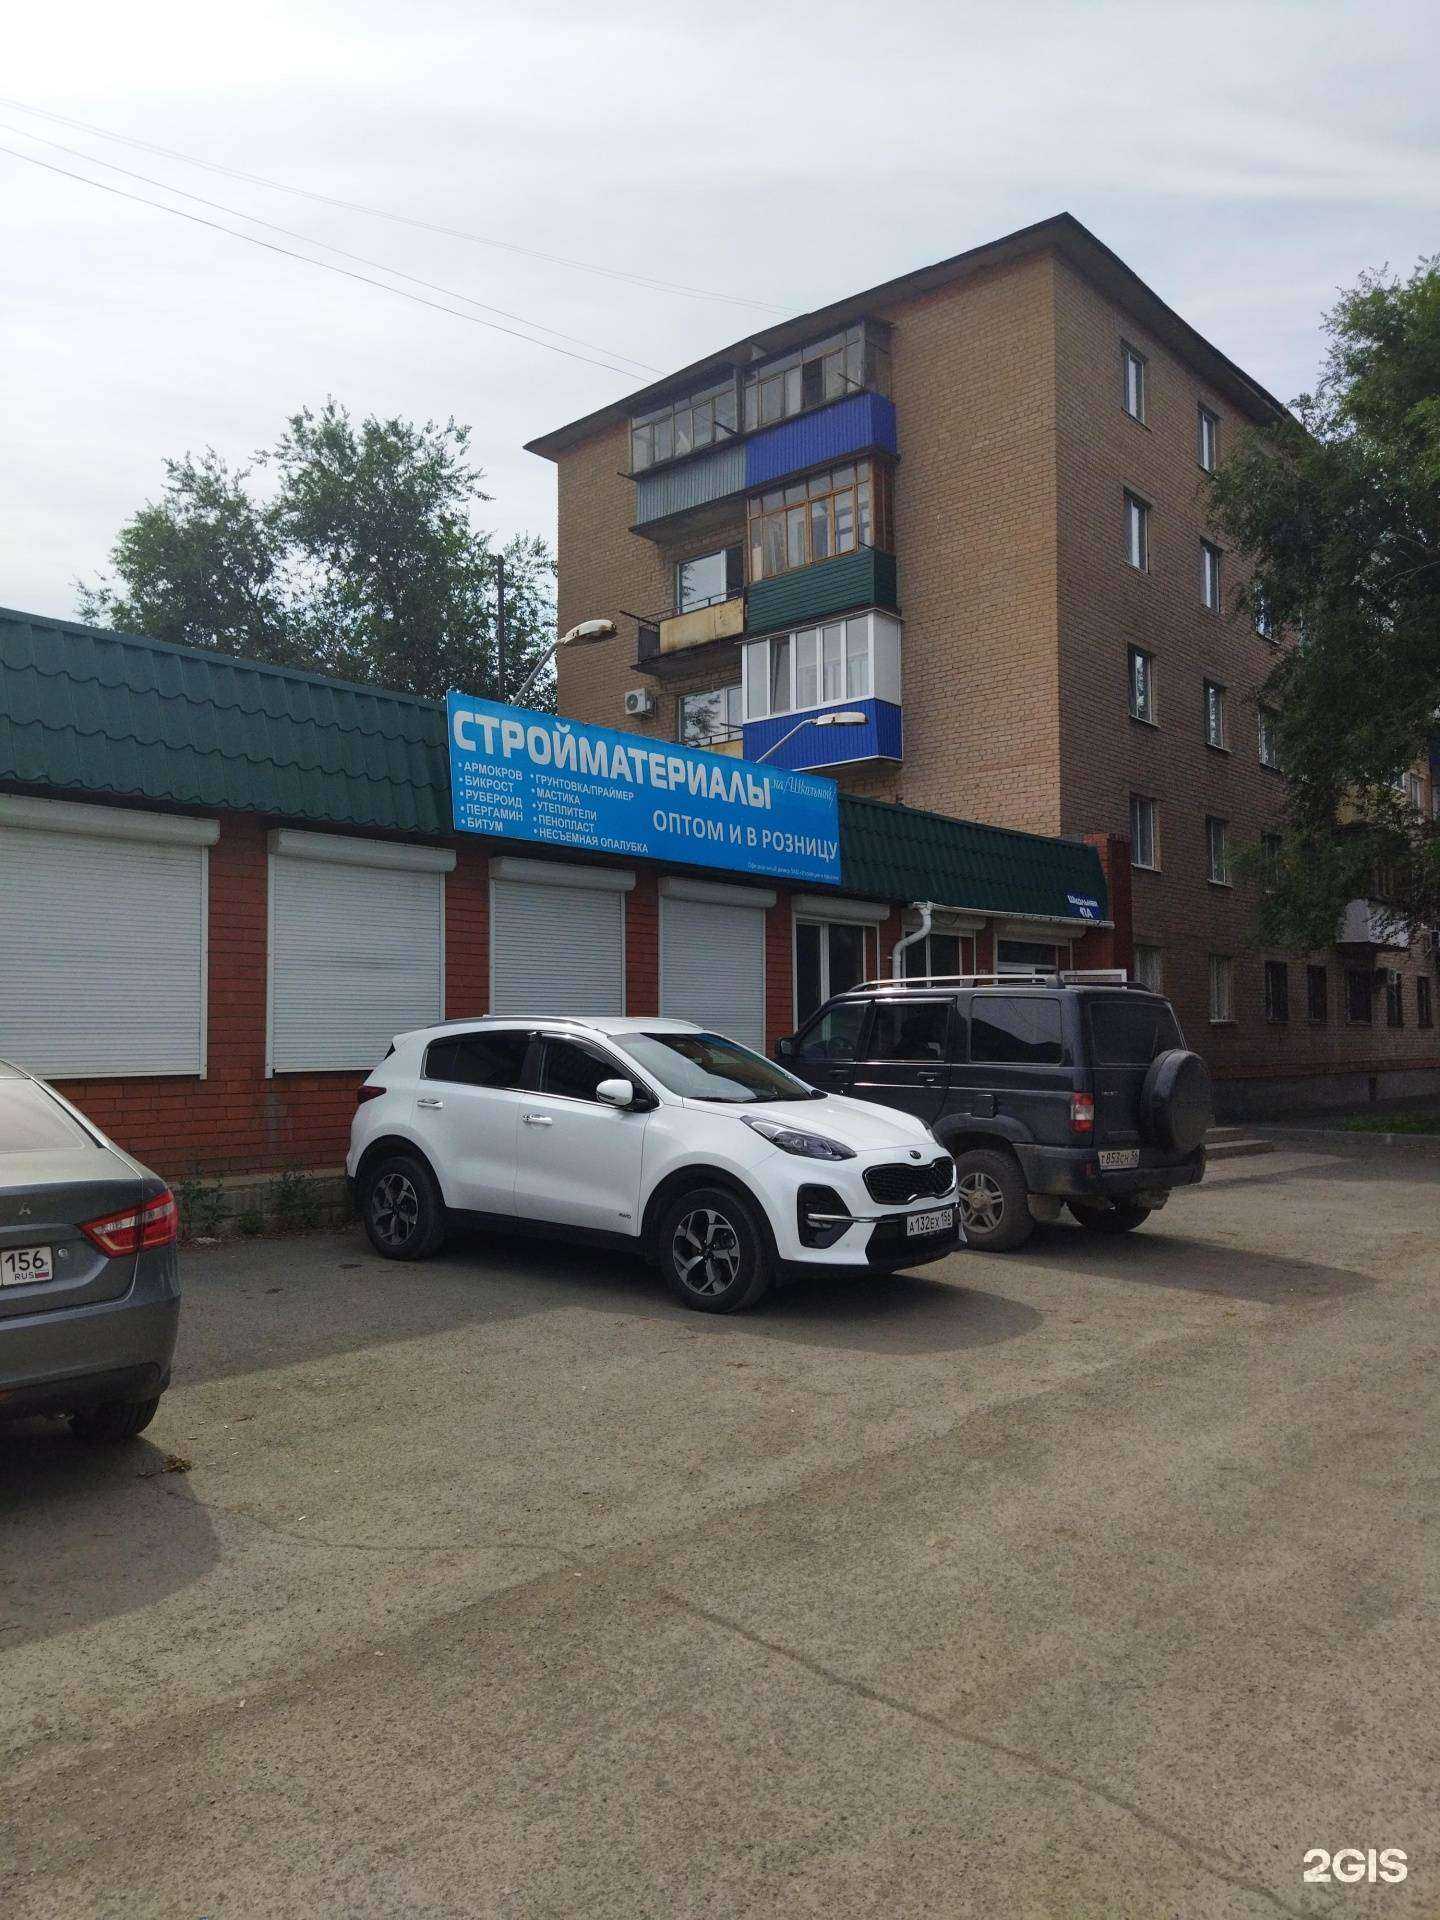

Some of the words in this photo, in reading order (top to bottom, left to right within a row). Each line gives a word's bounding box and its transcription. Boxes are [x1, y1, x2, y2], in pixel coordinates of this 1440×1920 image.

[453, 710, 772, 810] СТРОЙМАТЕРИАЛЫ
[464, 761, 523, 781] АРМОКРОВ
[465, 775, 514, 793] БИКРОСТ
[535, 775, 635, 801] ГРУНТОВКА/ПРАЙМЕР
[465, 789, 523, 809] РУБЕРОИД
[536, 788, 581, 805] МАСТИКА
[466, 803, 523, 821] ПЕРГАМИН
[537, 802, 597, 820] УТЕПЛИТЕЛИ
[467, 818, 503, 832] БИТУМ
[538, 815, 594, 833] ПЕНОПЛАСТ
[539, 828, 598, 847] НЕСЪЕМНАЯ
[600, 837, 649, 853] ОПАЛУБКА
[653, 810, 724, 842] ОПТОМ
[730, 823, 742, 845] И
[746, 826, 757, 847] В
[762, 829, 838, 863] РОЗНИЦУ
[5, 1250, 44, 1273] 156
[14, 1272, 35, 1281] RUS
